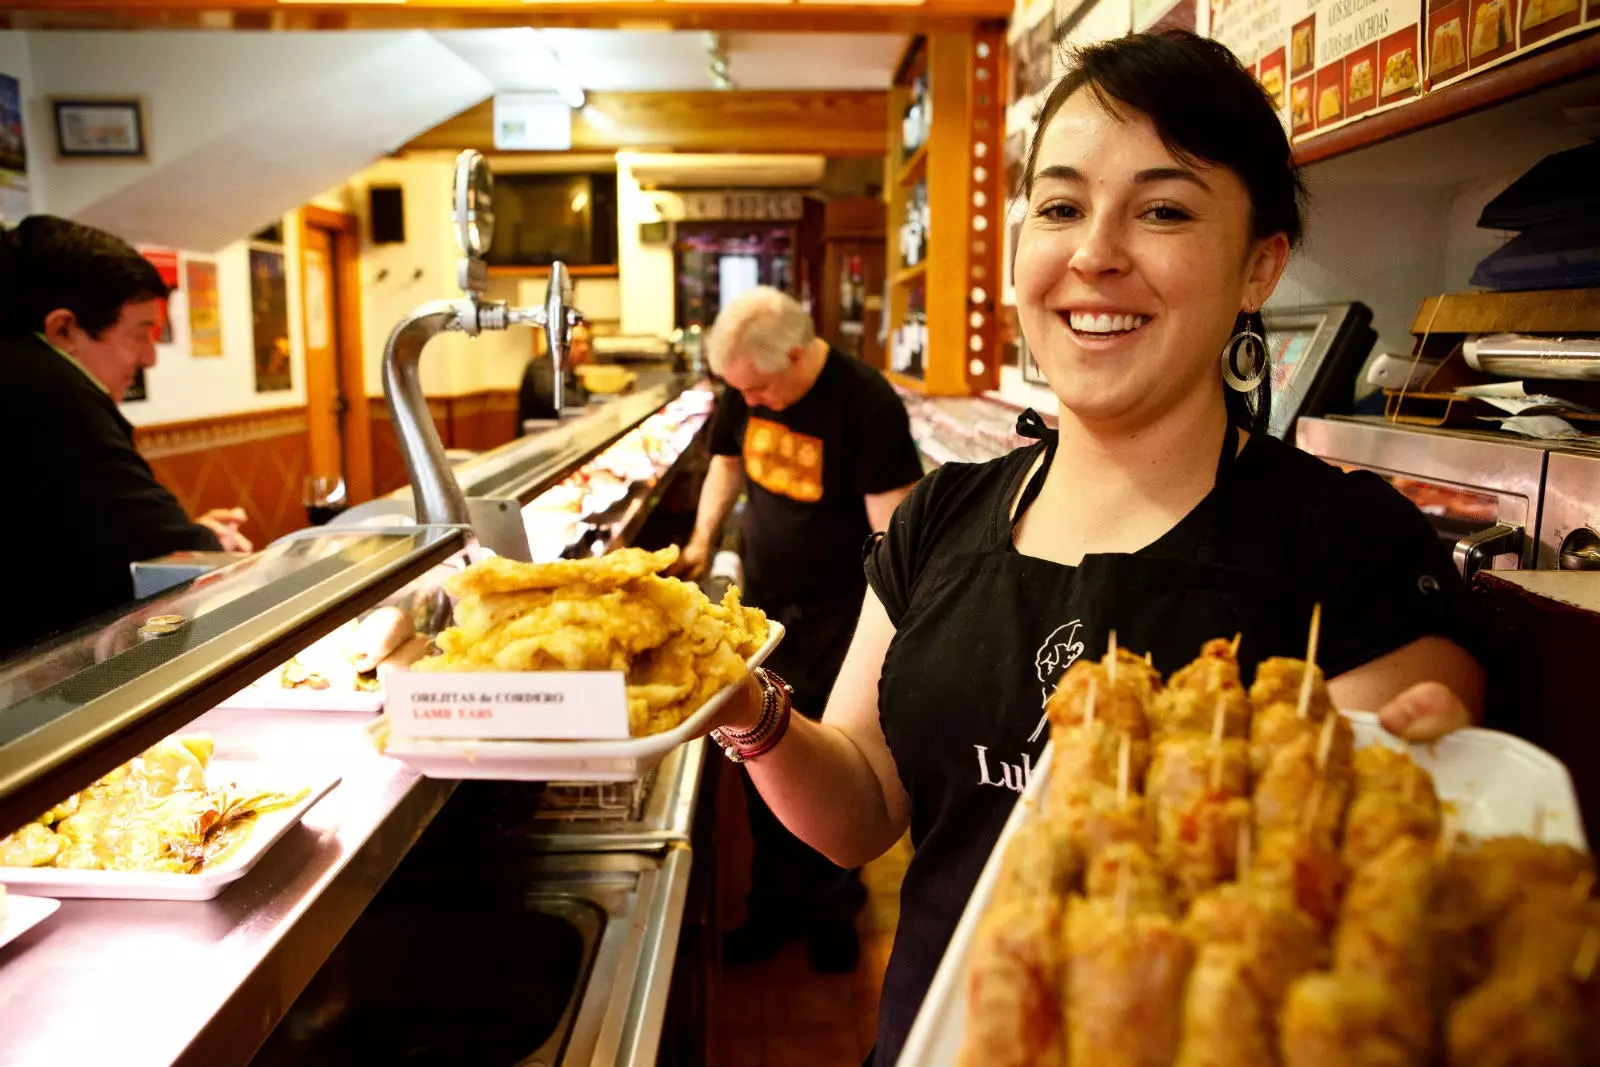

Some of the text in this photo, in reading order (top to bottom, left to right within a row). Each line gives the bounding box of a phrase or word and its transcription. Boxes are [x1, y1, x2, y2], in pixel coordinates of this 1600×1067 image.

[1353, 8, 1389, 46] ANCHOAS
[411, 692, 476, 704] OREJITAS
[495, 692, 565, 704] CORDERO
[413, 707, 494, 720] LAMB EARS
